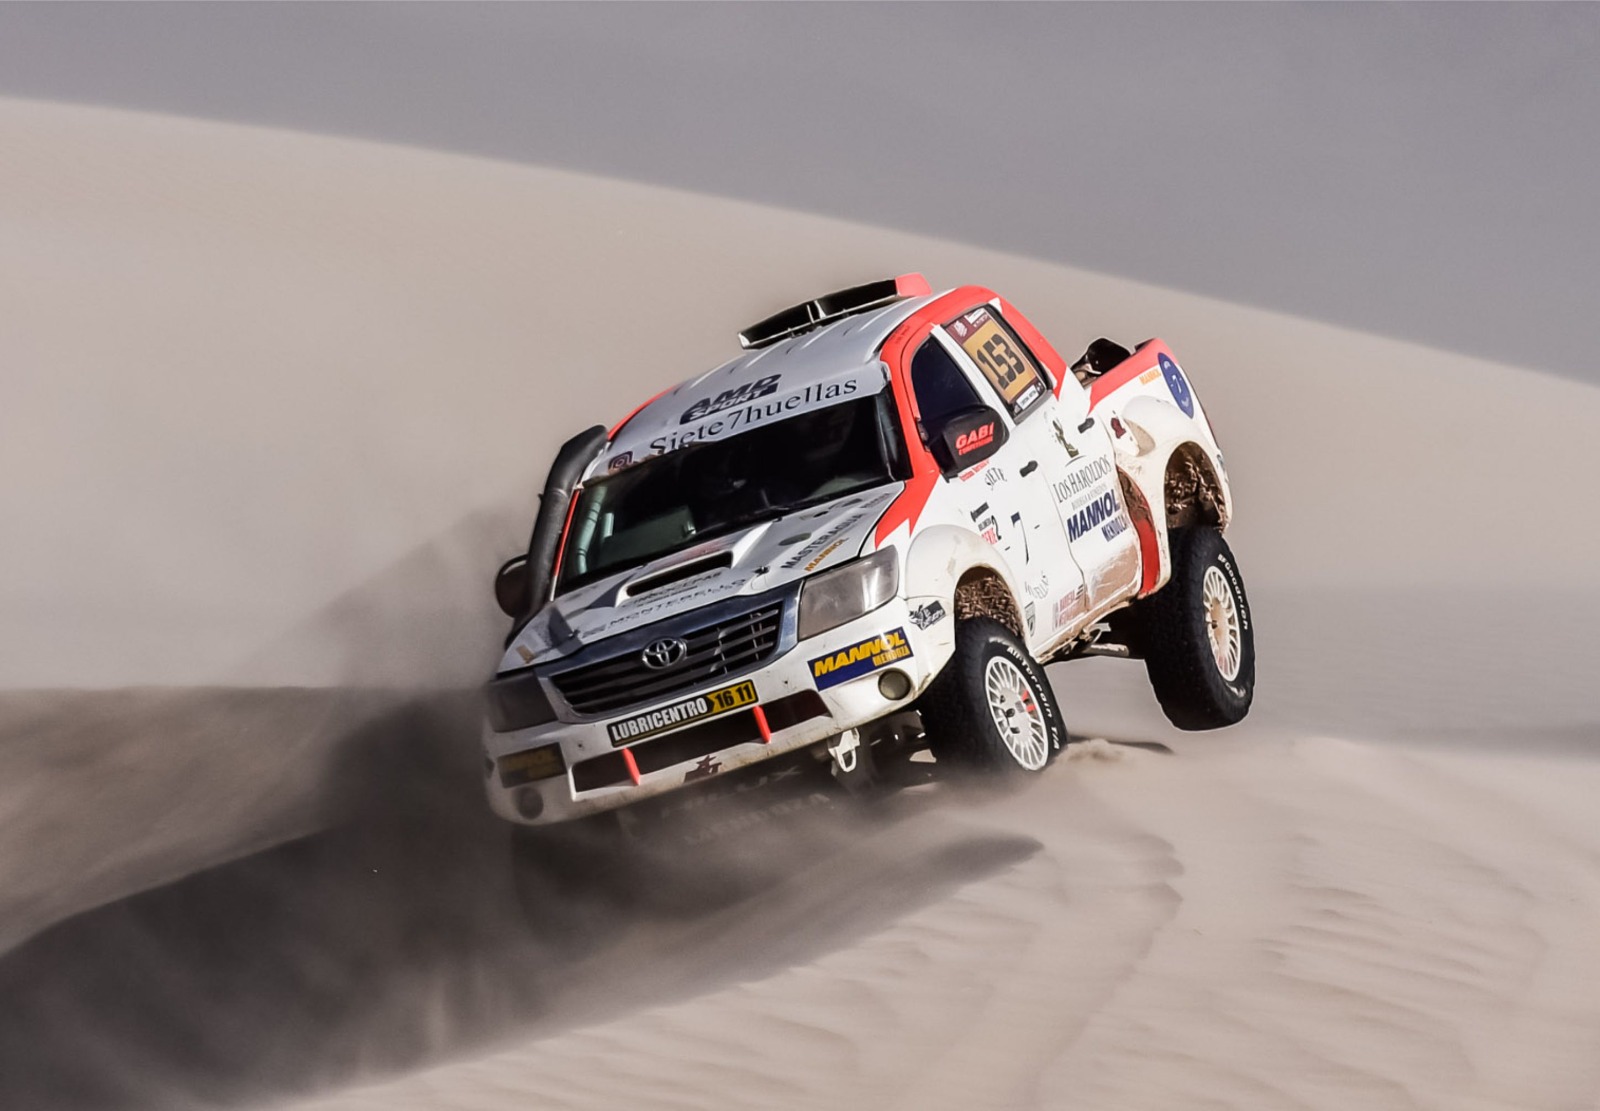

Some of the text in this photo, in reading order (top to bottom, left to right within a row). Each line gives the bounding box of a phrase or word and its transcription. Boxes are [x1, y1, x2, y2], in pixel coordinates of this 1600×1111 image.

[977, 333, 1025, 390] 153
[650, 379, 858, 455] Siete7huellas
[689, 387, 767, 421] SPORT
[956, 422, 994, 449] GABI
[1053, 479, 1073, 503] LOS
[1067, 454, 1112, 494] HAROLDOS
[1010, 511, 1029, 565] 7
[1067, 489, 1121, 543] MANNOL
[814, 633, 905, 677] MANNOL
[872, 645, 911, 668] MENDOZA
[611, 684, 754, 741] LUBRICENTRO 16 11
